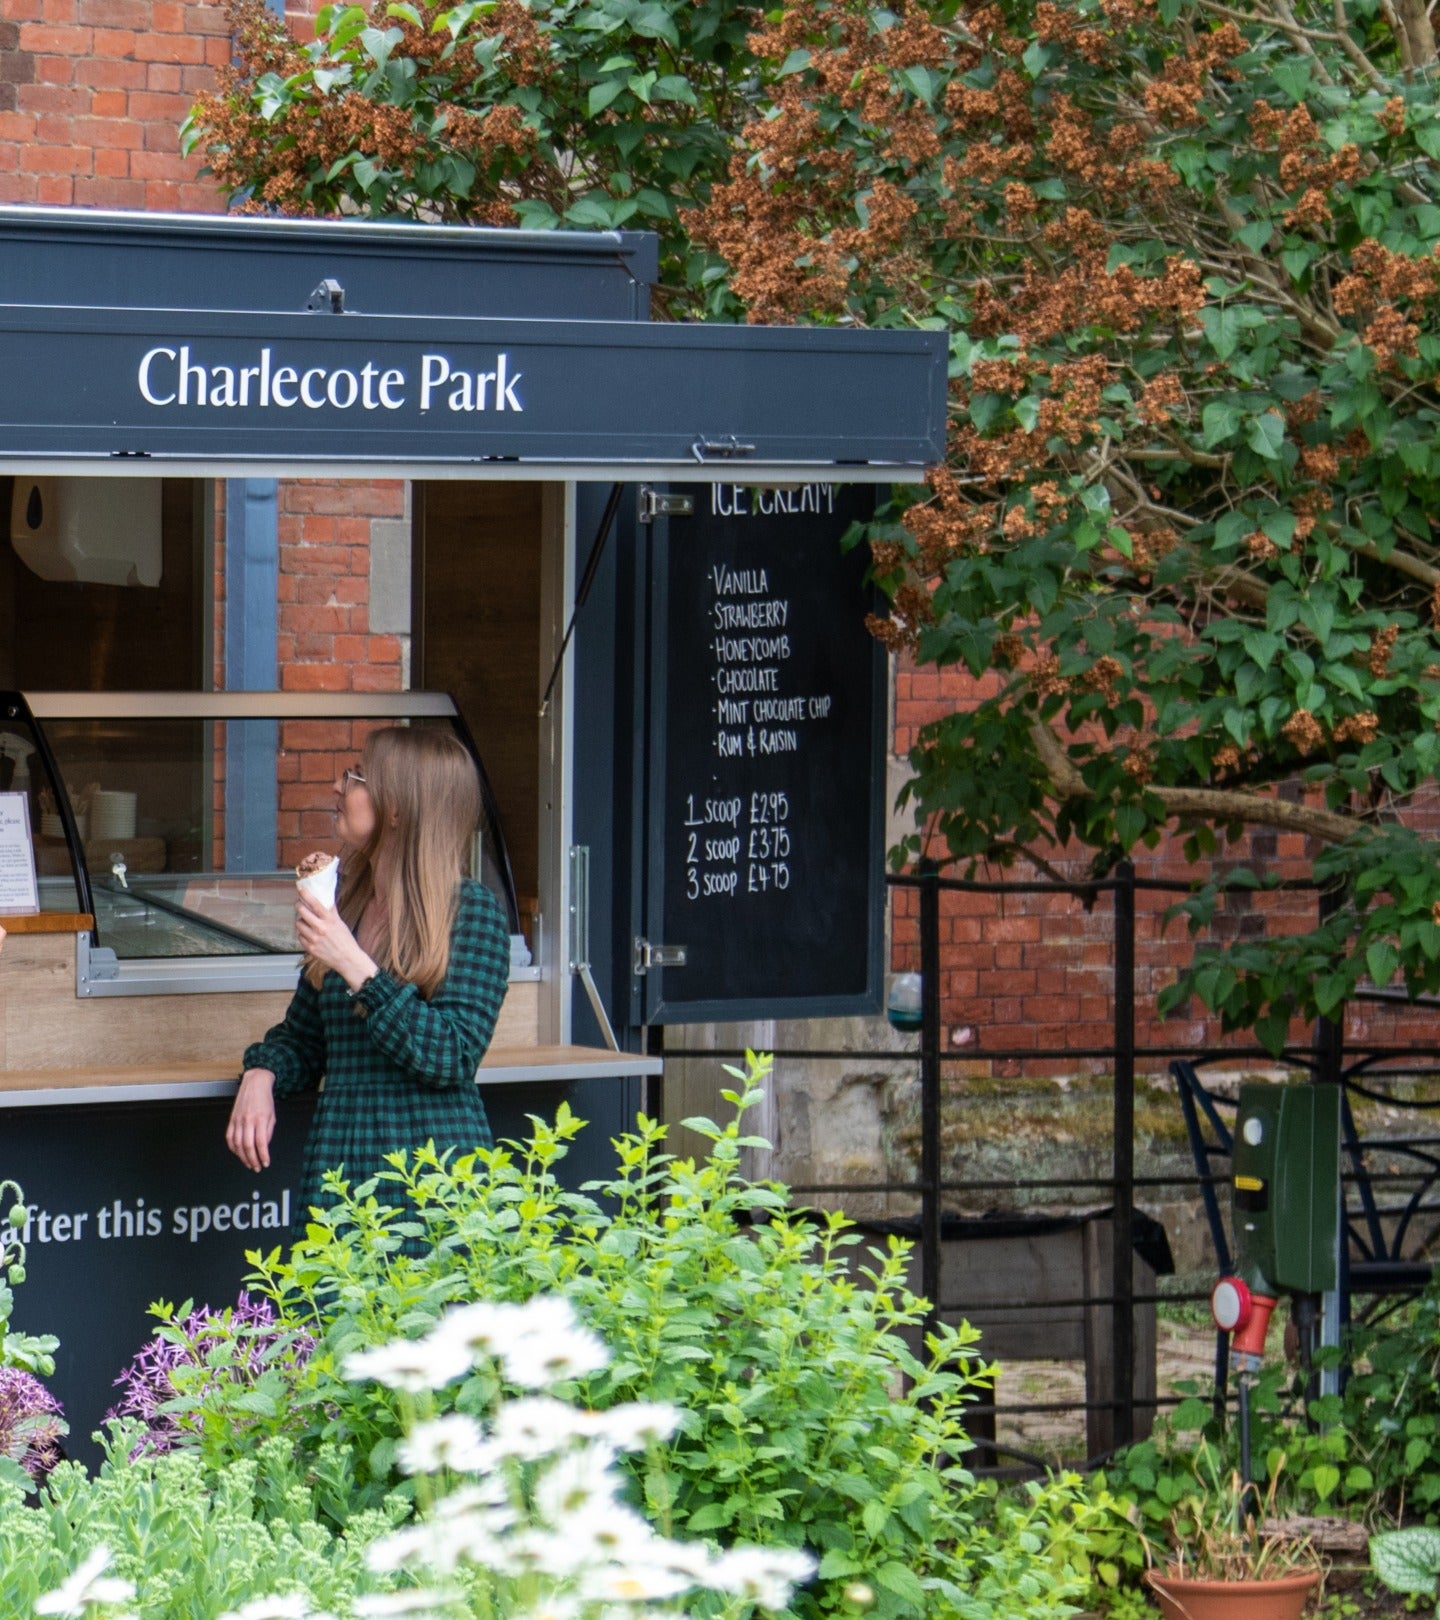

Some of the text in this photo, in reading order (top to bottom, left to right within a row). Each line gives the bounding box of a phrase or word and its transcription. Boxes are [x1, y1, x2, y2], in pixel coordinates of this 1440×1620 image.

[138, 346, 523, 411] Charlecote Park
[713, 564, 768, 595] VANILLA
[714, 600, 788, 630] STRAWBERRY
[715, 634, 790, 663] HONEYCOMB
[717, 667, 779, 694] CHOCOLATE
[718, 695, 831, 724] MINT CHOCOLATE CHIP
[718, 724, 797, 757] RUM & RAISIN
[684, 791, 789, 829] 1 scoop £2.95
[687, 832, 699, 863] 2
[705, 835, 740, 864] scoop
[687, 867, 699, 900] 3
[703, 871, 738, 897] scoop
[0, 1205, 88, 1246] after
[97, 1198, 162, 1238] this
[172, 1189, 290, 1242] special
